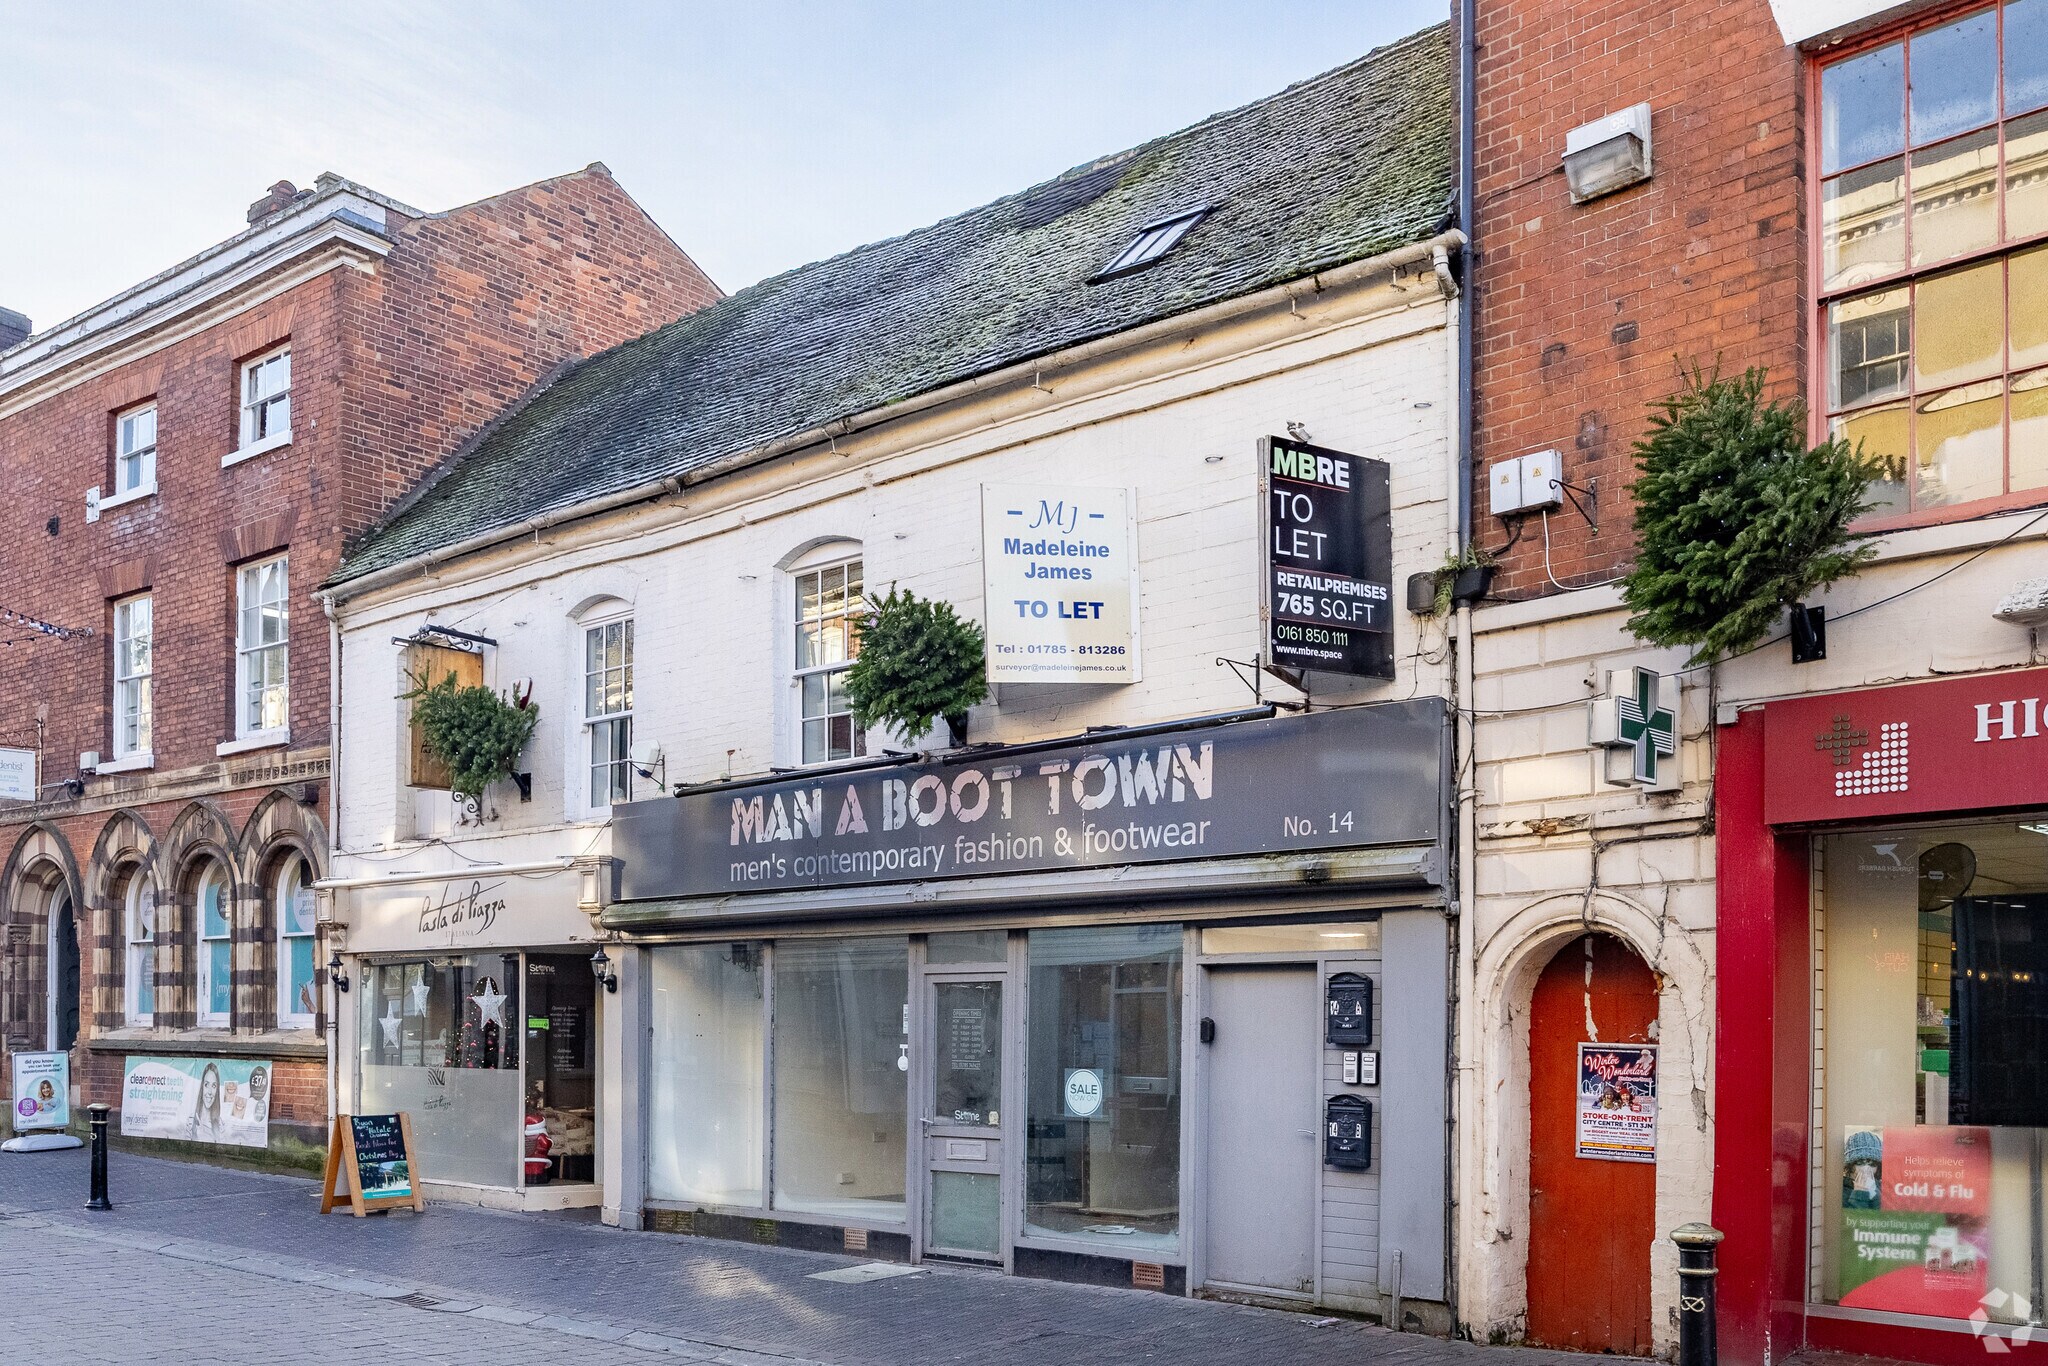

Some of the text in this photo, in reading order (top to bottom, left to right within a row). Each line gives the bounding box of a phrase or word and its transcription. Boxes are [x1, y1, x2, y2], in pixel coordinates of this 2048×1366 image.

[1274, 447, 1350, 488] MBRE
[1274, 490, 1314, 523] TO
[1004, 538, 1110, 558] Madeleine
[1275, 526, 1327, 560] LET
[1024, 562, 1092, 580] James
[1014, 600, 1104, 620] TO LET
[1278, 592, 1375, 624] 765 SQ.FT
[1277, 625, 1348, 646] 0161 850 1111
[995, 644, 1015, 654] Tel
[1027, 645, 1067, 654] 01785
[1078, 645, 1126, 655] 813286
[1276, 645, 1343, 660] www.mbre.space
[995, 663, 1127, 672] surveyor@madeleinejames.co.uk
[1974, 698, 2048, 742] HI
[730, 740, 1214, 846] MAN A BOOT TOWN
[1284, 811, 1354, 838] No. 14
[730, 820, 1212, 882] men's contemporary fashion & footwear
[418, 882, 449, 933] Pasta
[468, 880, 506, 935] Piazza
[1584, 1053, 1620, 1072] Winter
[1597, 1062, 1652, 1081] Wonderland
[129, 1086, 184, 1104] straightening
[1070, 1084, 1098, 1095] SALE
[1582, 1112, 1653, 1122] STOKE-ON-TRENT
[1581, 1148, 1652, 1159] winterwonderlandstoke.com
[1904, 1156, 1964, 1167] Helps relieve
[1903, 1168, 1965, 1180] symptoms of
[1894, 1182, 1974, 1199] Cold & Flu
[1846, 1217, 1930, 1231] by supporting your
[1854, 1229, 1921, 1245] Immune
[1858, 1244, 1916, 1261] System
